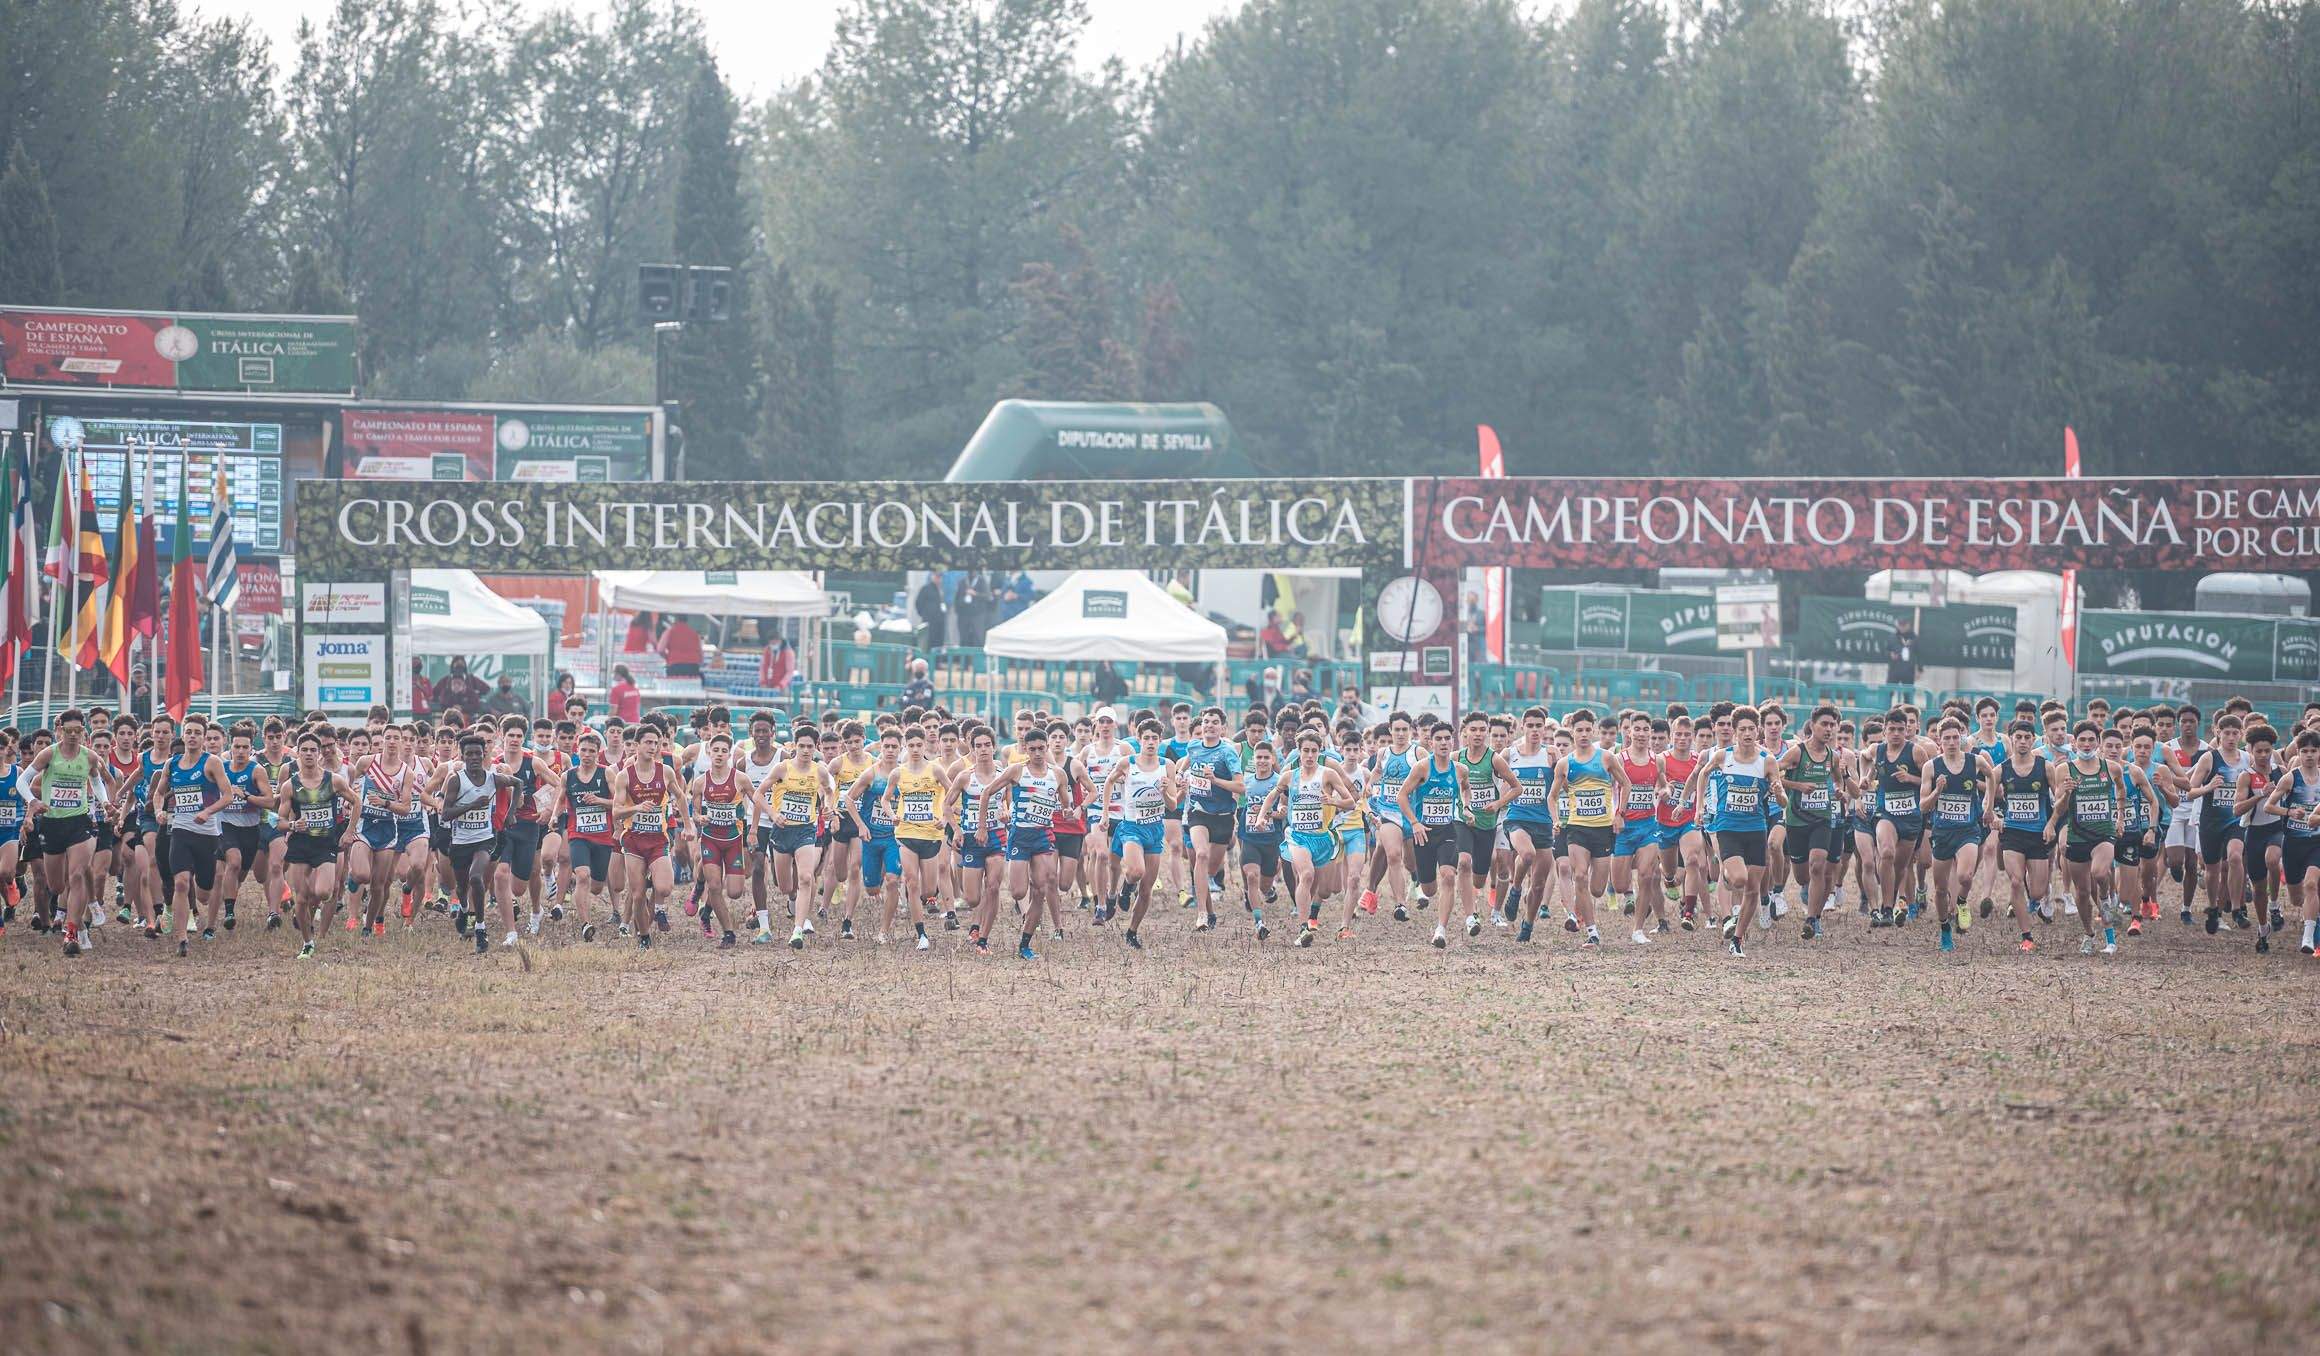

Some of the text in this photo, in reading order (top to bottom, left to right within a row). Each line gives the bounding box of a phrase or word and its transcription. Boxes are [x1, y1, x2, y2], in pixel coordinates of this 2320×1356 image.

[24, 320, 129, 336] CAMPEONATO
[26, 332, 47, 343] DE
[238, 330, 301, 339] INTERNACIONAL
[211, 339, 286, 354] ITÁLICA
[353, 419, 426, 431] CAMPEONATO
[530, 432, 590, 448] ITÁLICA
[1057, 429, 1213, 450] DIPUTACION DE SEVILLA
[2194, 488, 2320, 520] DE CAM
[338, 486, 1369, 549] CROSS INTERNACIONAL DE ITÁLICA
[1442, 487, 2189, 546] CAMPEONATO DE ESPAÑA
[2194, 526, 2320, 558] POR CLU
[1659, 604, 1717, 634] DIPU
[1837, 608, 1899, 626] DIPUTACIO
[1835, 638, 1883, 654] SEVIL
[2101, 623, 2238, 660] DIPUTACION
[54, 788, 79, 799] 2775
[1473, 790, 1491, 799] 384
[1522, 787, 1543, 797] 448
[1631, 793, 1653, 802] 1329
[1807, 790, 1826, 800] 1441
[2218, 790, 2235, 799] 127
[176, 793, 200, 805] 1324
[1579, 797, 1602, 807] 1469
[1731, 794, 1755, 804] 1450
[785, 801, 809, 814] 1253
[907, 803, 929, 812] 1254
[1426, 805, 1450, 816] 1396
[1889, 801, 1913, 810] 1264
[1941, 802, 1967, 812] 1263
[2012, 801, 2035, 811] 1260
[2081, 802, 2106, 812] 1442
[0, 808, 13, 817] 34
[305, 809, 329, 820] 1339
[462, 810, 486, 821] 1413
[710, 810, 733, 819] 1498
[1295, 811, 1319, 822] 1286
[580, 814, 602, 825] 1241
[636, 813, 660, 824] 1500
